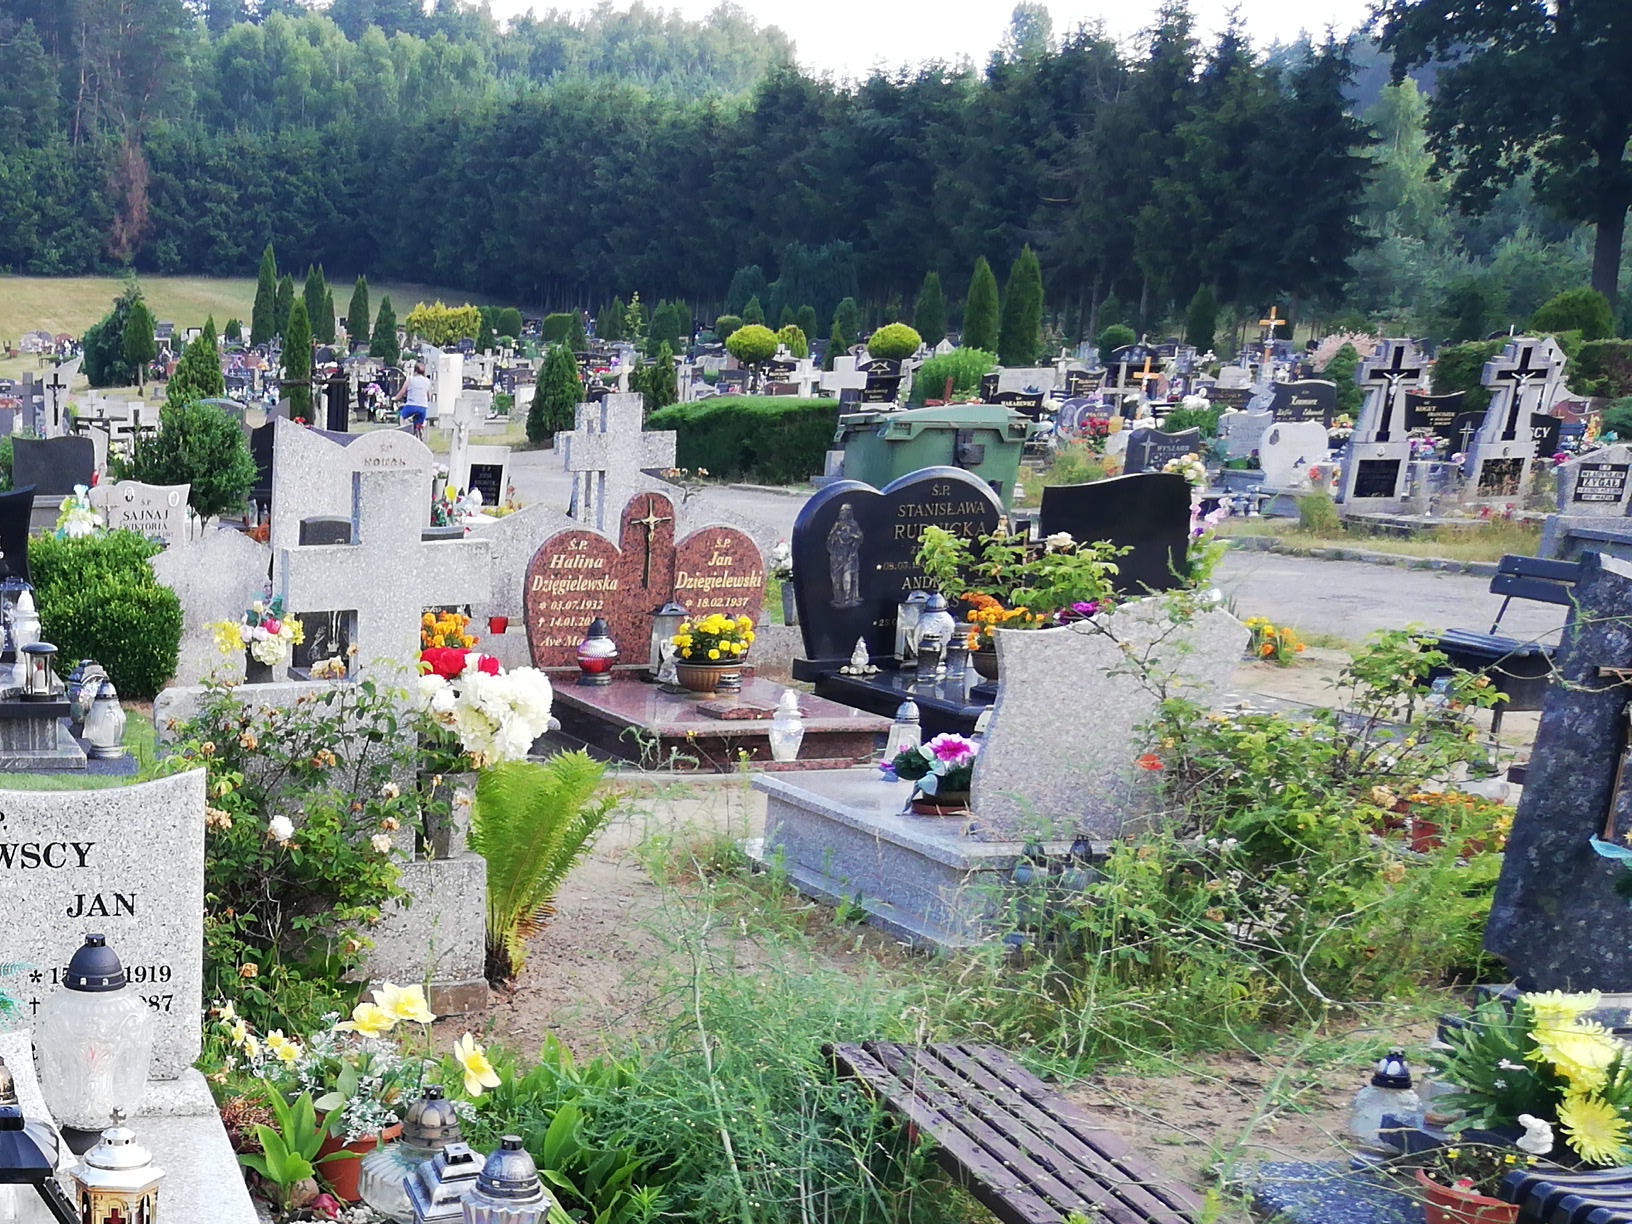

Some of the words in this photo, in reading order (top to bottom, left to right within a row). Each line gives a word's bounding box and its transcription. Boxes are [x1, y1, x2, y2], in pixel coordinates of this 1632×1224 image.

[897, 501, 986, 518] STANISŁAWA
[549, 554, 604, 569] Halina
[708, 550, 733, 567] Jan
[532, 574, 619, 596] Dzięgielewska
[551, 600, 604, 611] 03.07.1932
[697, 597, 750, 608] 18.02.1937
[66, 893, 138, 918] JAN
